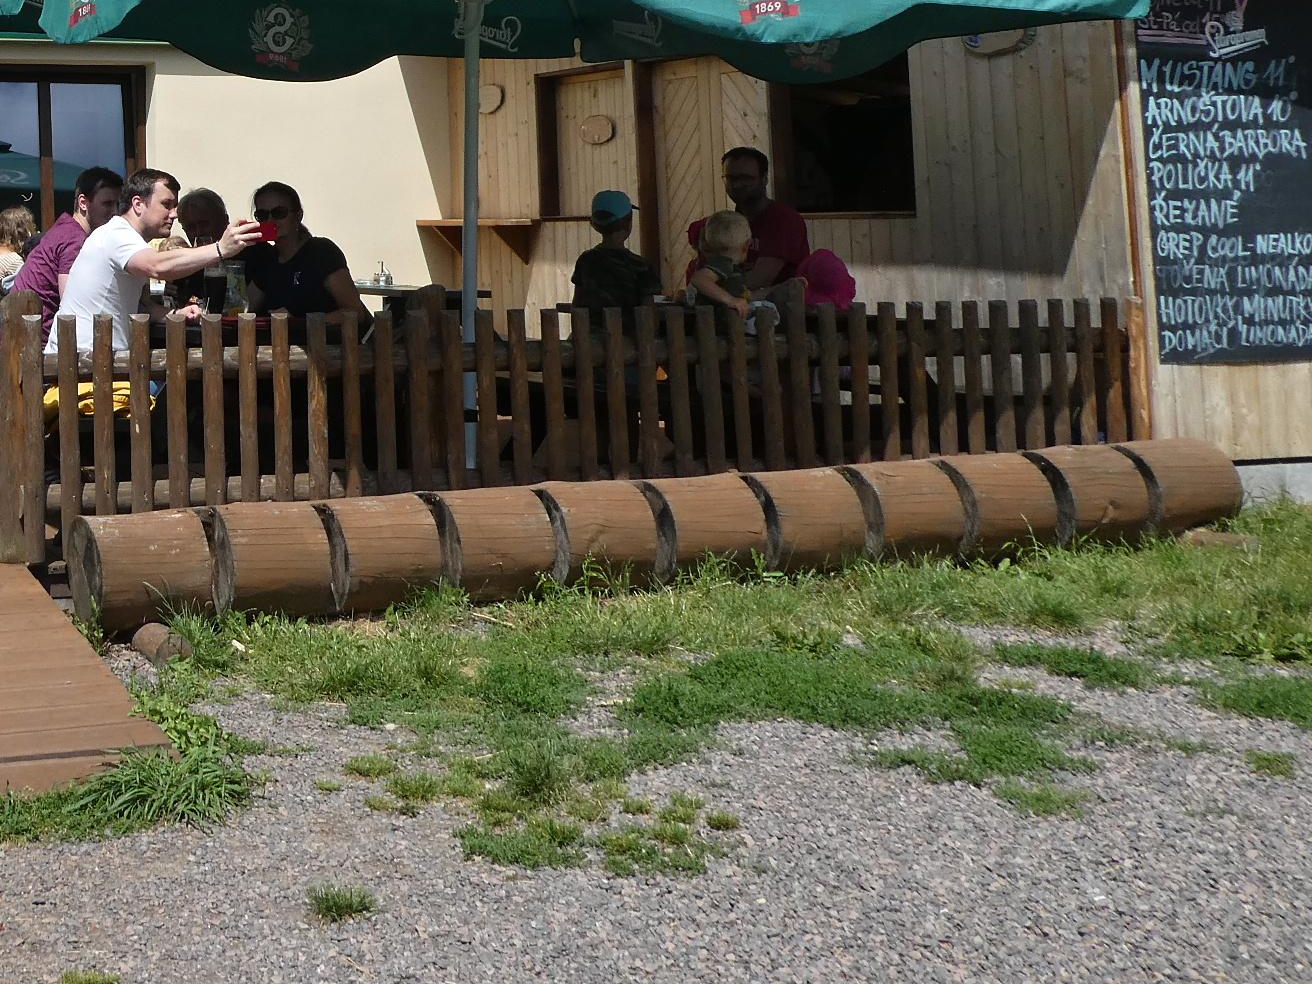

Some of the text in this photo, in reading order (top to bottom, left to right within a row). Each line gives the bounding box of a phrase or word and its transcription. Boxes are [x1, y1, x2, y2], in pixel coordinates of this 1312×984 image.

[755, 1, 782, 14] 1869
[1140, 57, 1257, 93] MUSTANG
[1145, 90, 1264, 126] ARNOŠTOVA
[1149, 123, 1308, 160] ČERNÁ BARBORA
[1149, 158, 1233, 190] POLIČKA
[1157, 230, 1204, 260] GREP
